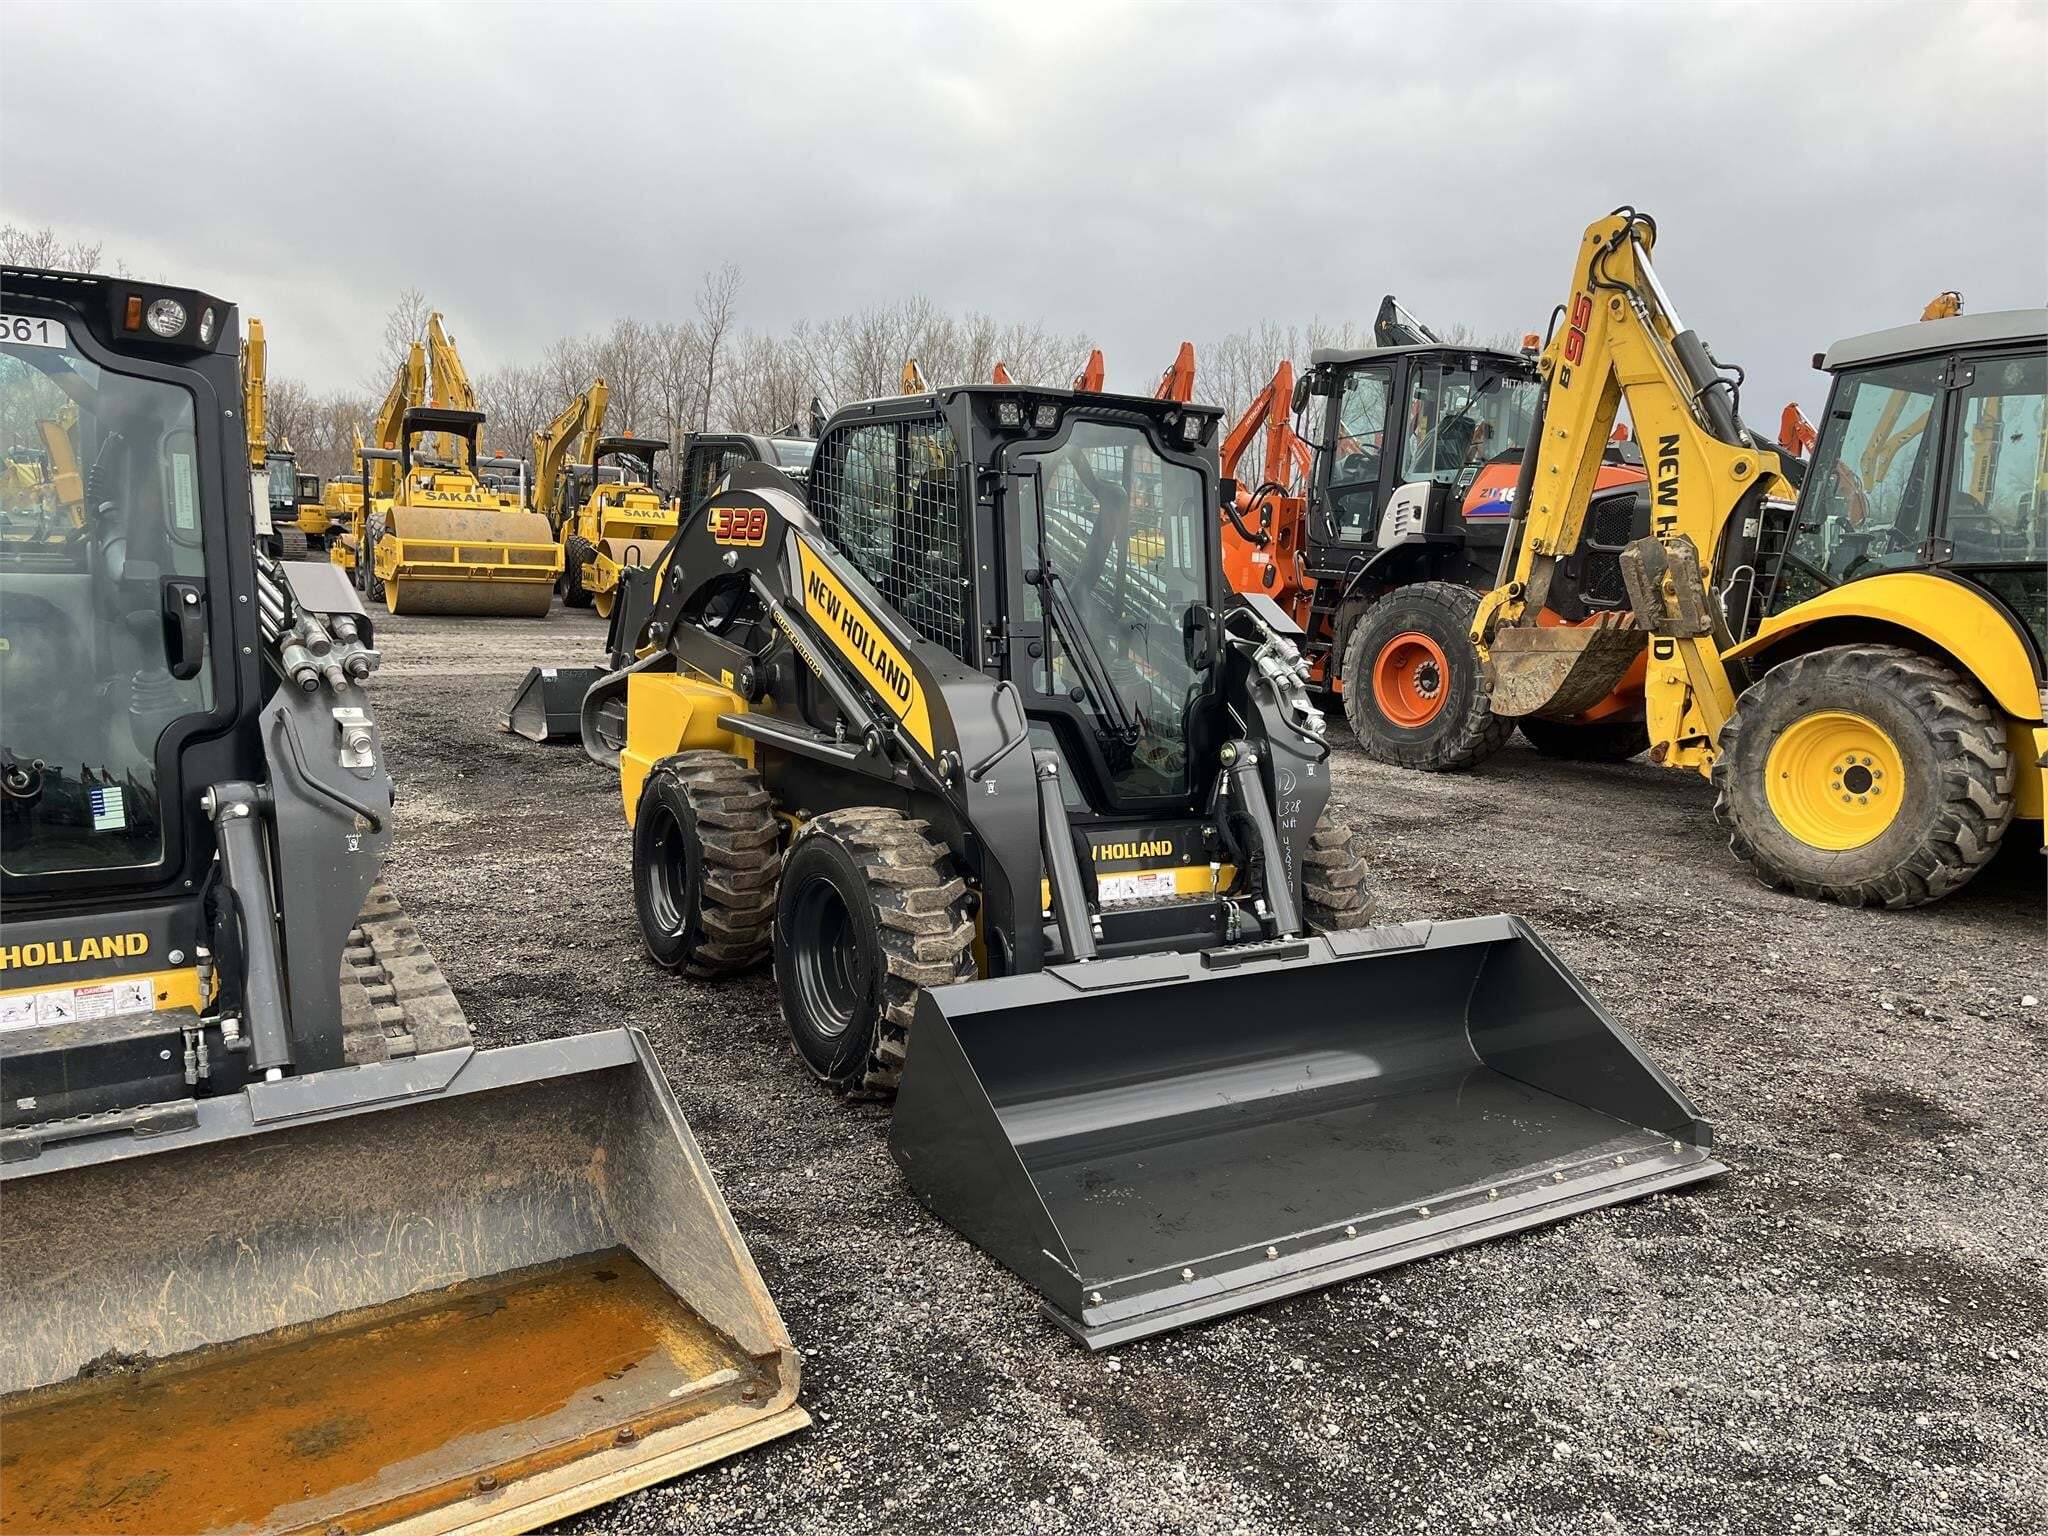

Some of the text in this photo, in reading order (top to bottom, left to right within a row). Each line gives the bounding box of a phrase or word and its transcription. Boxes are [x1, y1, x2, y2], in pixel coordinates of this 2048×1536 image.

[1657, 434, 1680, 507] NEW
[425, 491, 482, 503] SAKAI
[624, 509, 666, 519] SAKAI
[706, 507, 768, 547] L328
[808, 570, 911, 702] NEW HOLLAND
[1101, 840, 1173, 861] HOLLAND
[0, 932, 149, 970] HOLLAND
